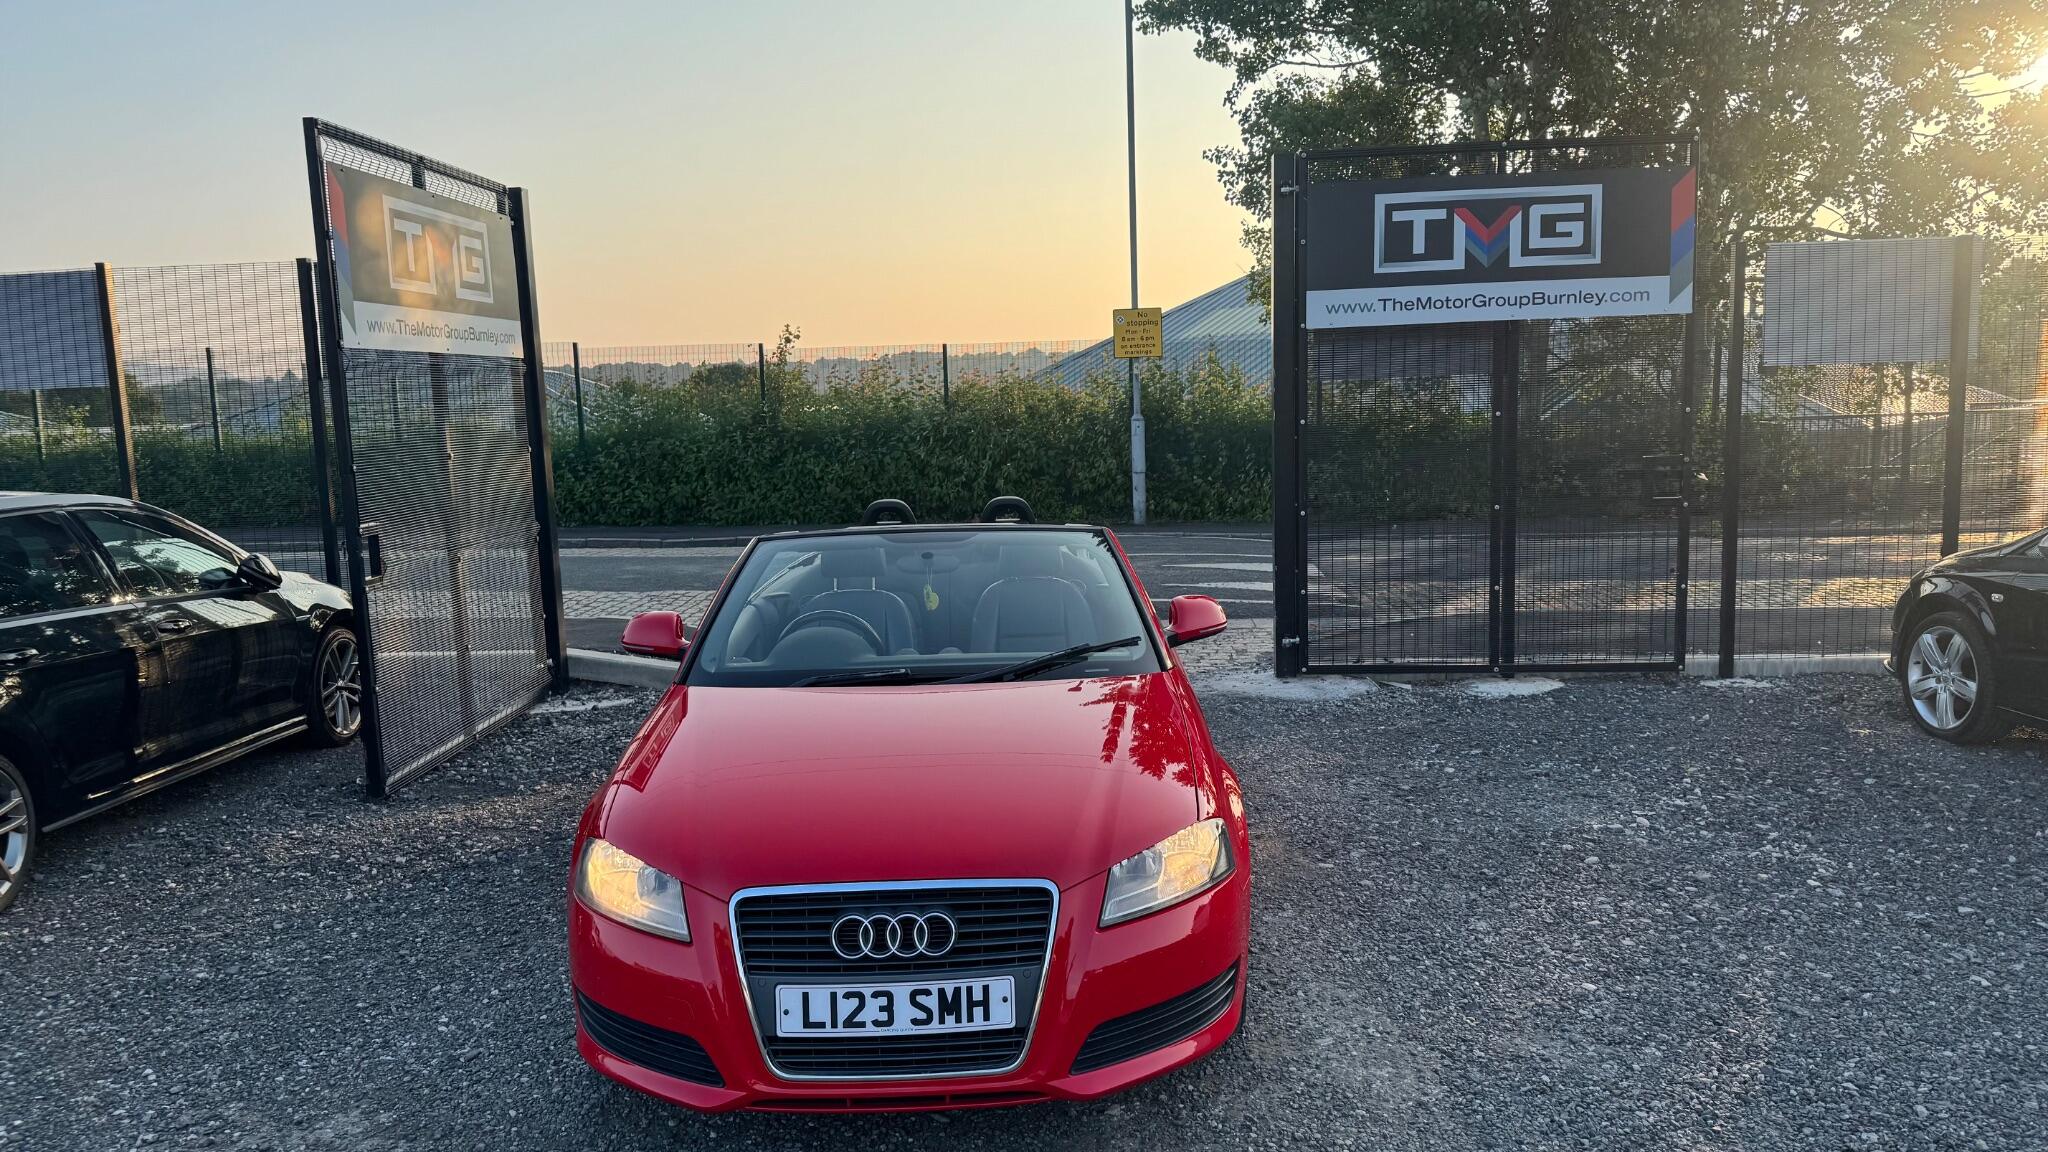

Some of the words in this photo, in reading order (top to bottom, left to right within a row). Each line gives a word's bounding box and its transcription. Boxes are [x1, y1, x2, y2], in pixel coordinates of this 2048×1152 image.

[1392, 202, 1585, 269] TMG
[394, 217, 485, 297] TMG
[1325, 289, 1650, 315] www.TheMotorGroupBurnley.com
[366, 319, 516, 346] www.TheMotorGroupBurnley.com
[1126, 319, 1159, 327] stopping
[909, 984, 991, 1027] SMH
